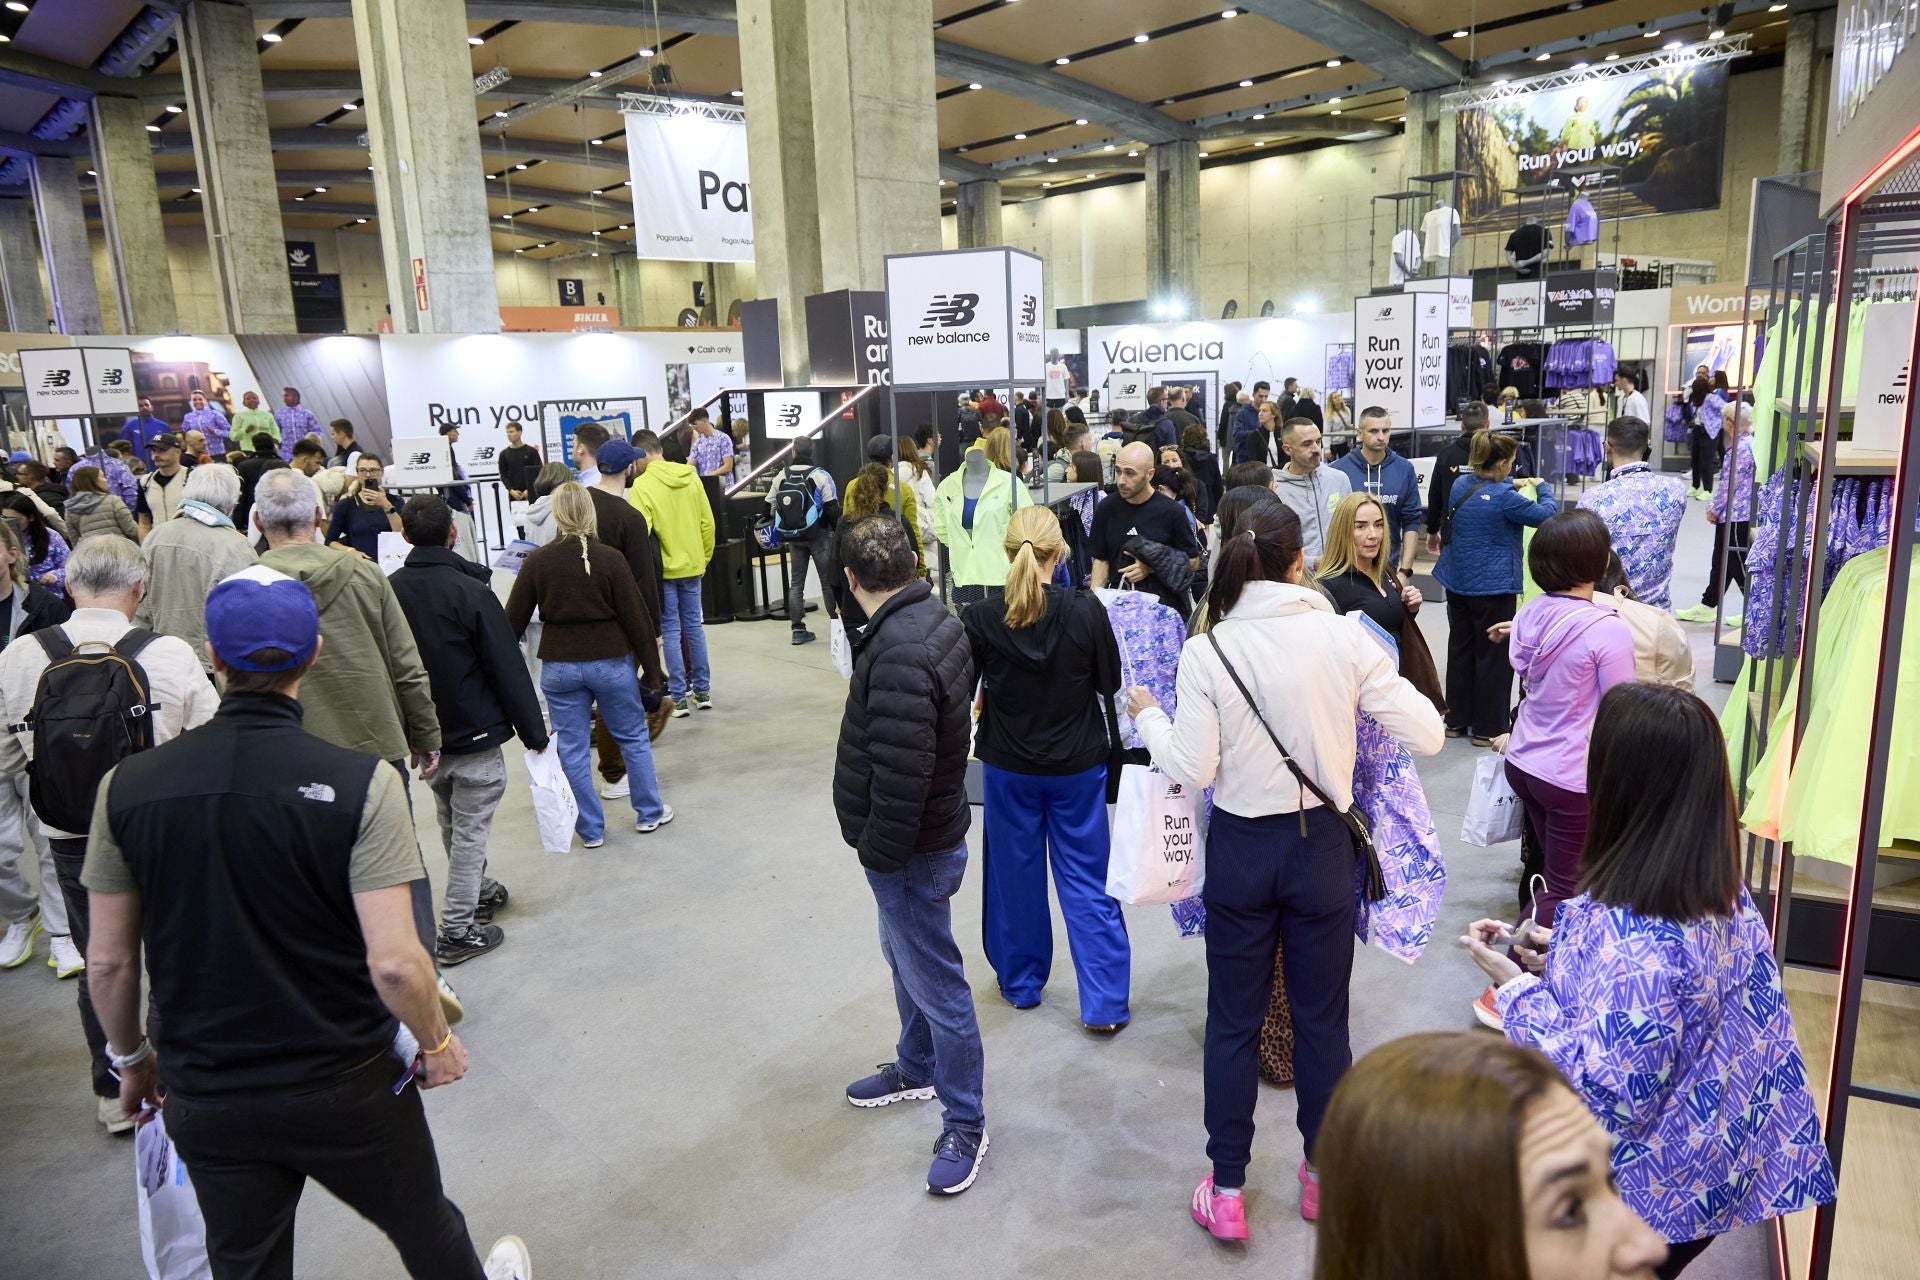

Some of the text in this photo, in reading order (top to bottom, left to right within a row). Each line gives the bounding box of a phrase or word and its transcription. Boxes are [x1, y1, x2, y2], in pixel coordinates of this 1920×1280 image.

[1519, 139, 1643, 172] Run your way.
[699, 169, 751, 213] Pa
[566, 281, 576, 295] B
[864, 314, 888, 338] Ru
[908, 331, 991, 346] new balance
[1368, 336, 1400, 353] Run
[1422, 333, 1440, 349] Run
[717, 346, 732, 354] only
[866, 344, 889, 363] ar
[1102, 338, 1224, 364] Valencia
[1365, 357, 1403, 375] your
[1420, 355, 1441, 373] your
[1365, 376, 1403, 393] way.
[1420, 374, 1441, 391] way.
[51, 388, 79, 396] balance
[1878, 393, 1906, 404] new
[428, 403, 481, 427] Run
[490, 404, 539, 428] you
[1164, 815, 1190, 830] Run
[1163, 833, 1193, 850] your
[1163, 849, 1194, 865] way.
